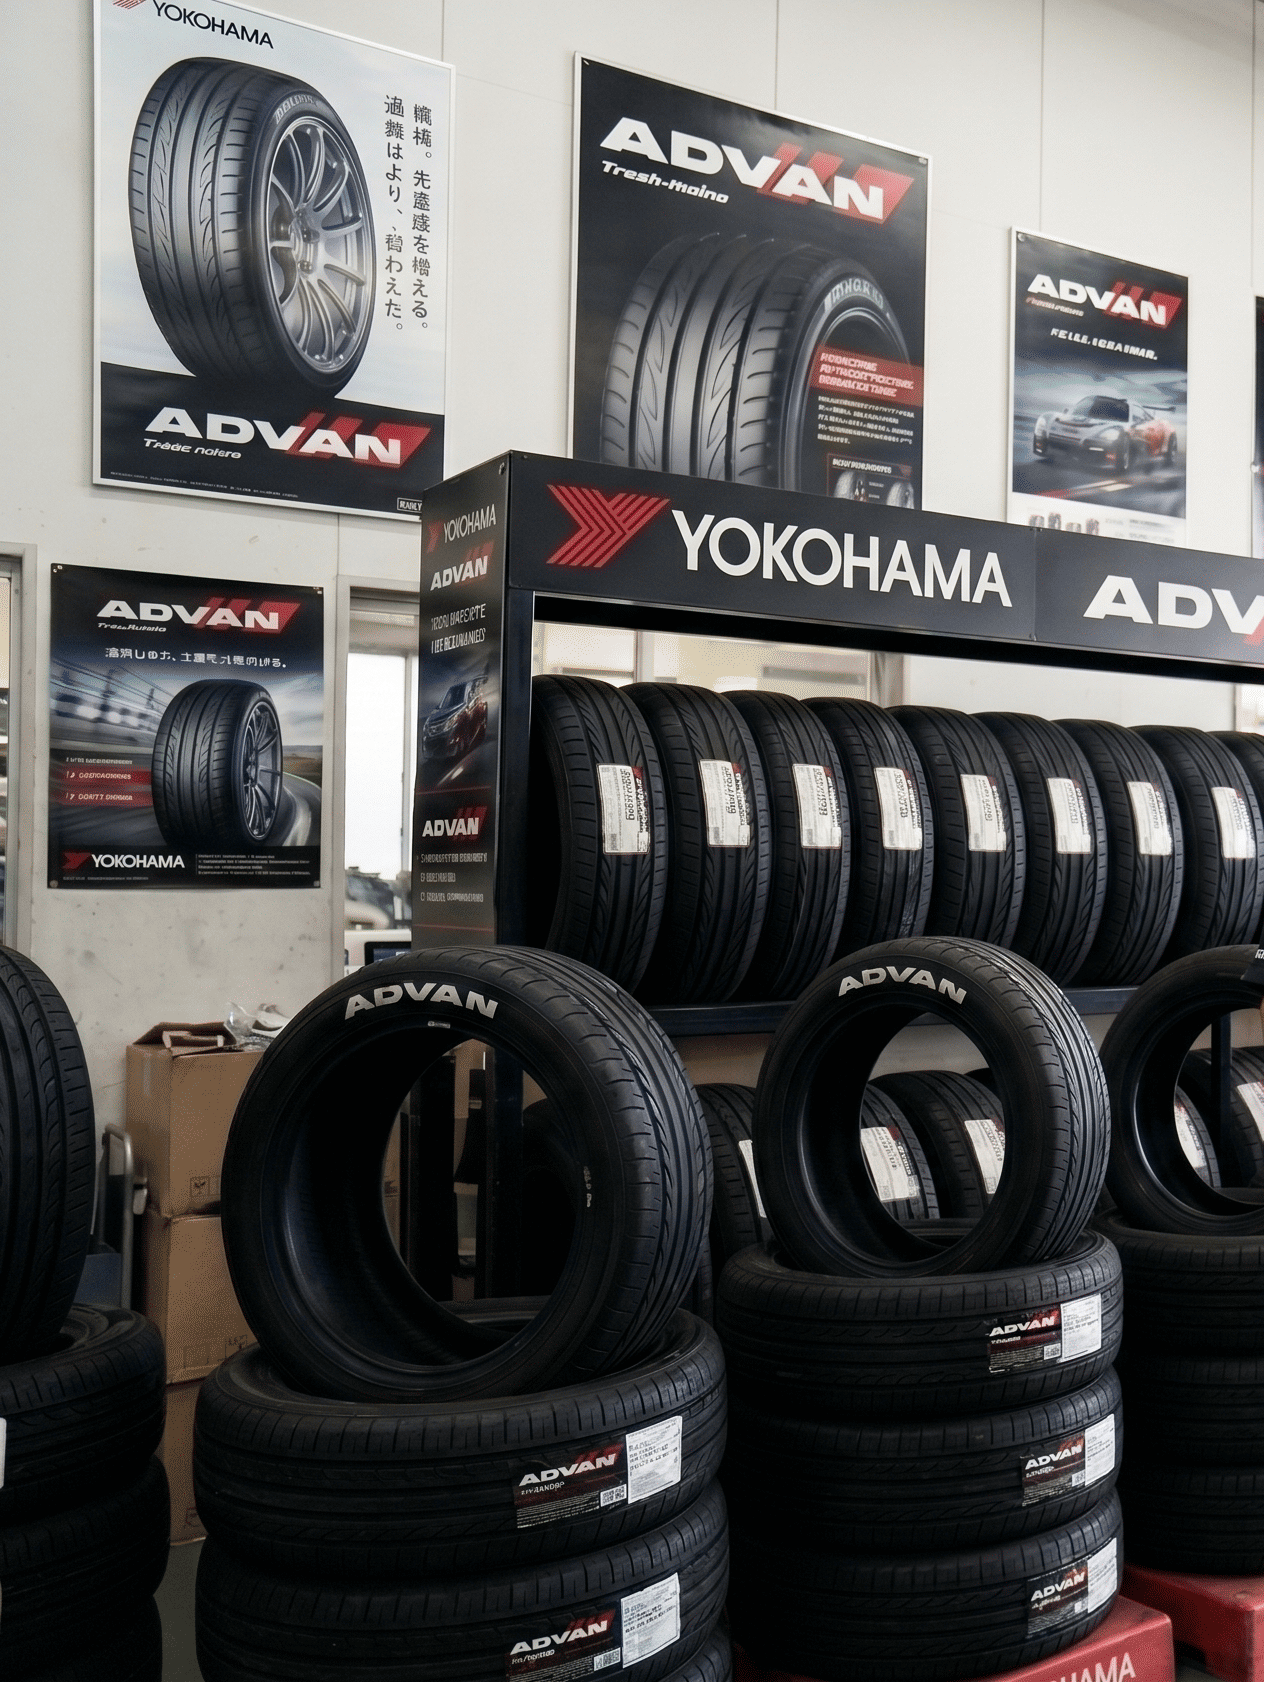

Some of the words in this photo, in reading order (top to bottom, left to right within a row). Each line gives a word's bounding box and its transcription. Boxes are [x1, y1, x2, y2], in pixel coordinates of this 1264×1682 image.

[153, 2, 274, 49] YOKOHAMA
[600, 117, 883, 219] ADVAN
[1027, 273, 1166, 325] ADVAN
[145, 406, 401, 465] ADVAN
[430, 556, 489, 591] ADVAN
[672, 509, 1013, 608] YOKOHAMA
[97, 599, 279, 630] ADVAN
[422, 817, 480, 837] ADVAN
[91, 854, 185, 869] YOKOHAMA
[344, 982, 499, 1020] ADVAN
[838, 966, 967, 1004] ADVAN
[989, 1316, 1055, 1337] ADVAN
[518, 1453, 617, 1487] ADVAN
[1025, 1445, 1083, 1471] ADVAN
[1030, 1572, 1085, 1602] ADVAN
[509, 1620, 608, 1656] ADVAN
